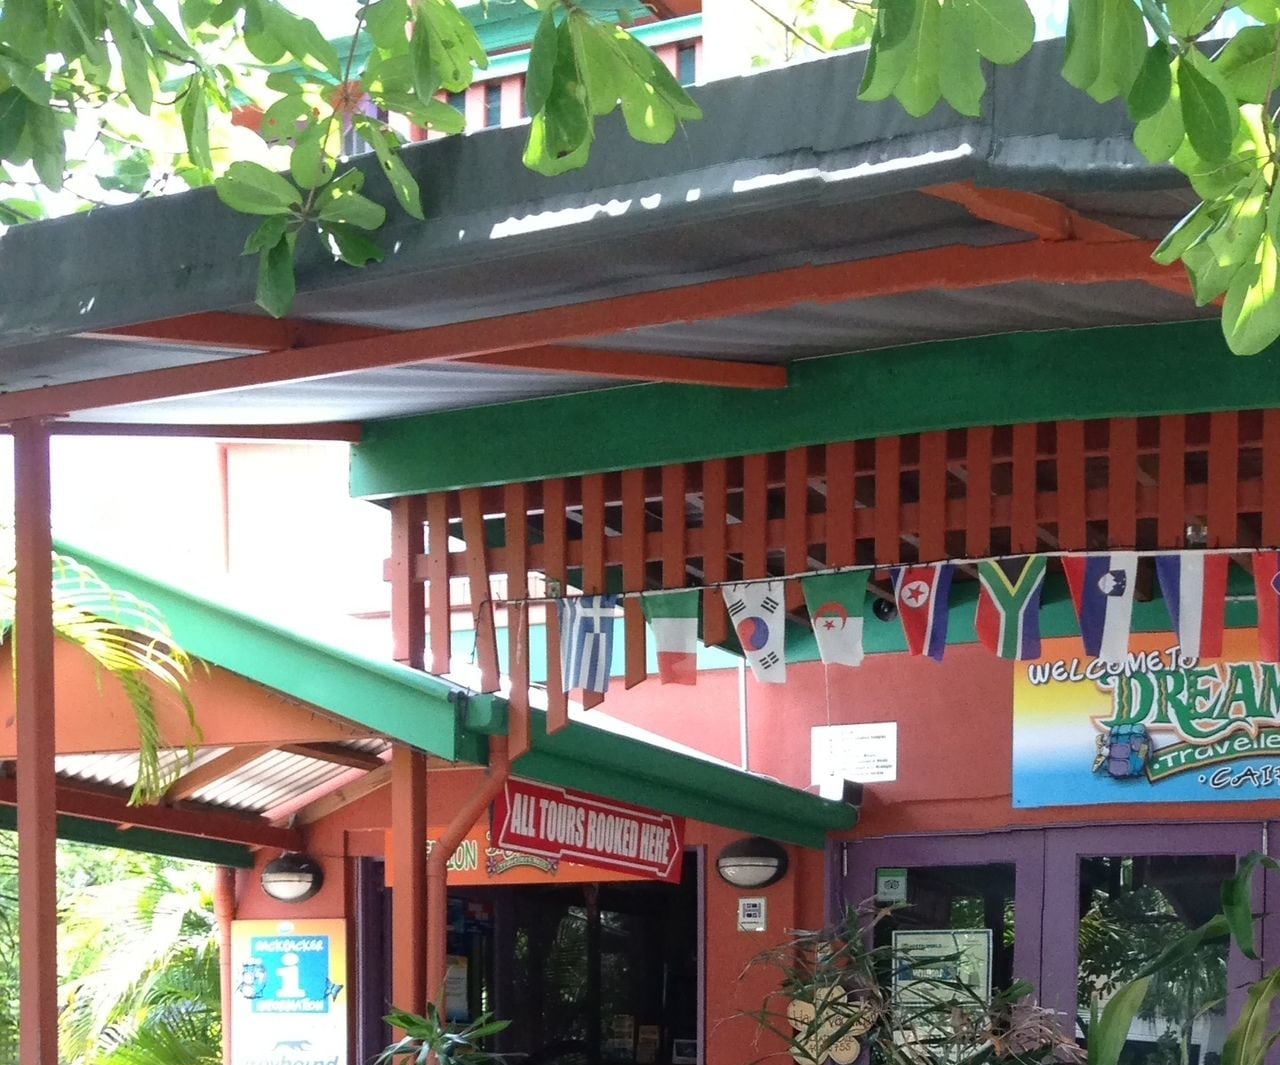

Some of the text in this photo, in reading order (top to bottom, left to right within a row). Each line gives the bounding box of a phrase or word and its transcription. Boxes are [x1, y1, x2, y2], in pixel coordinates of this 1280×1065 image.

[1028, 646, 1197, 685] WELCOME TO
[510, 793, 537, 838] ALL
[540, 799, 585, 847] TOURS
[587, 810, 639, 858] BOOKED
[640, 822, 671, 865] HERE
